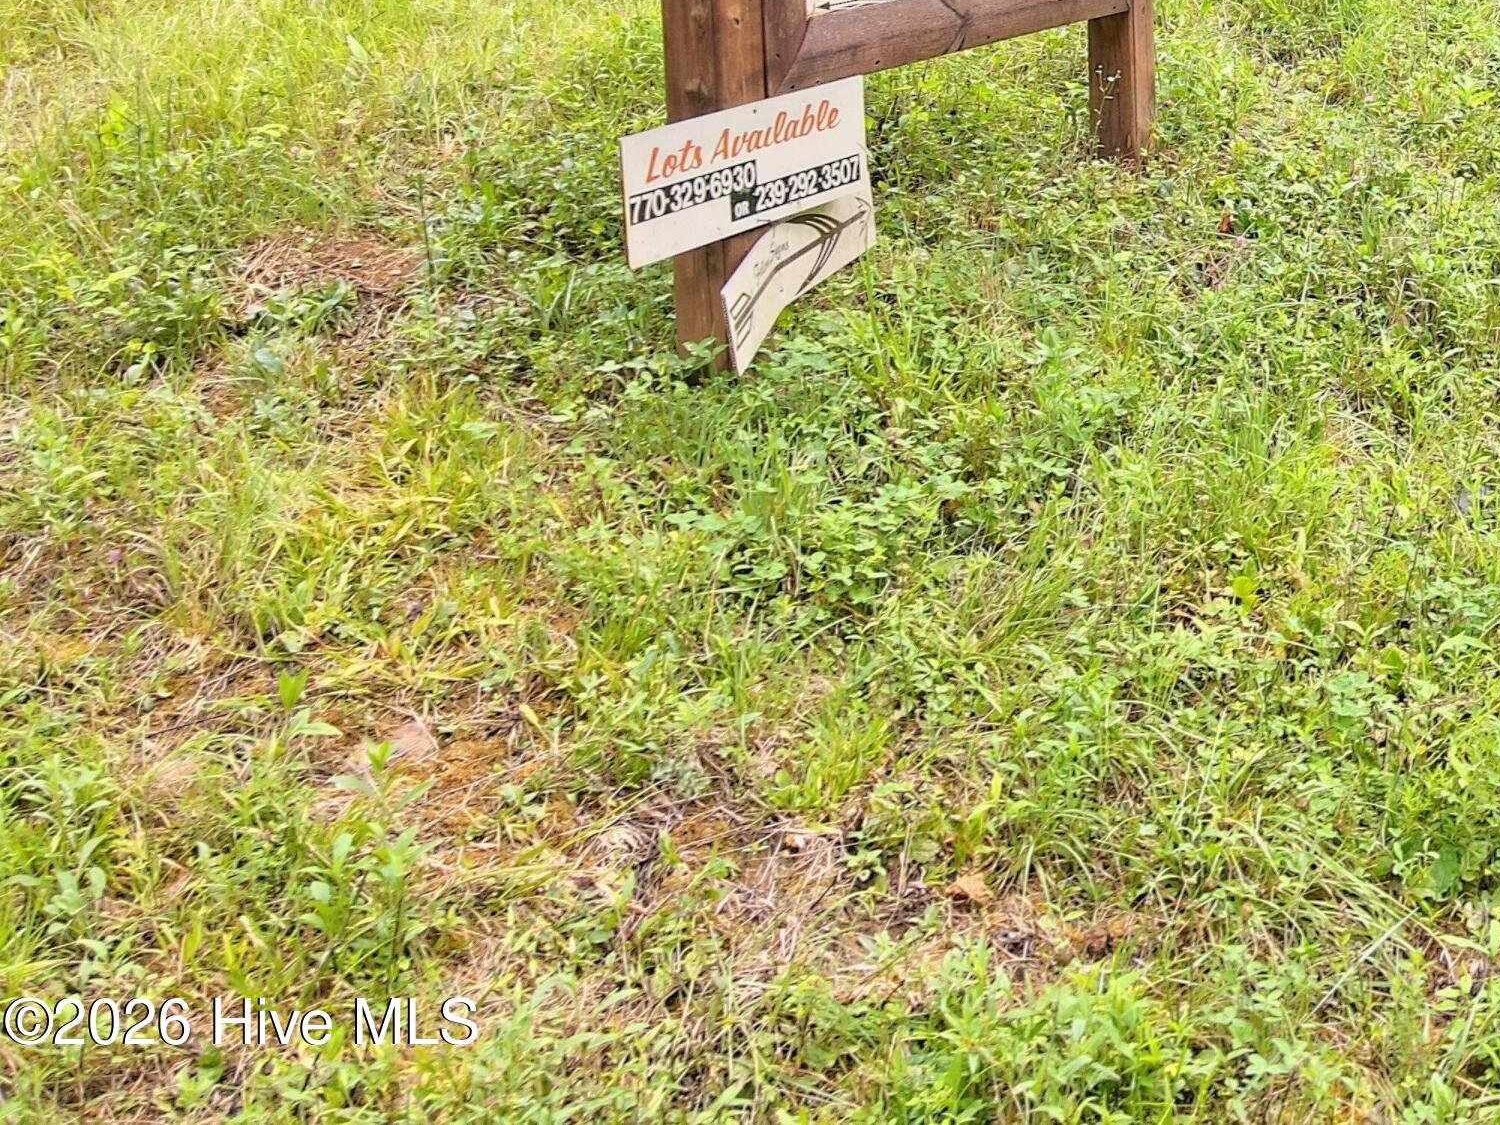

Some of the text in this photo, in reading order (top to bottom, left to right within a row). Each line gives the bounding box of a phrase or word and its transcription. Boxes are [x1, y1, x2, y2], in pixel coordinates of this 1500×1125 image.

[645, 100, 840, 184] Lots Available
[630, 162, 755, 223] 770-329-6930
[752, 156, 859, 211] 239-292-3507
